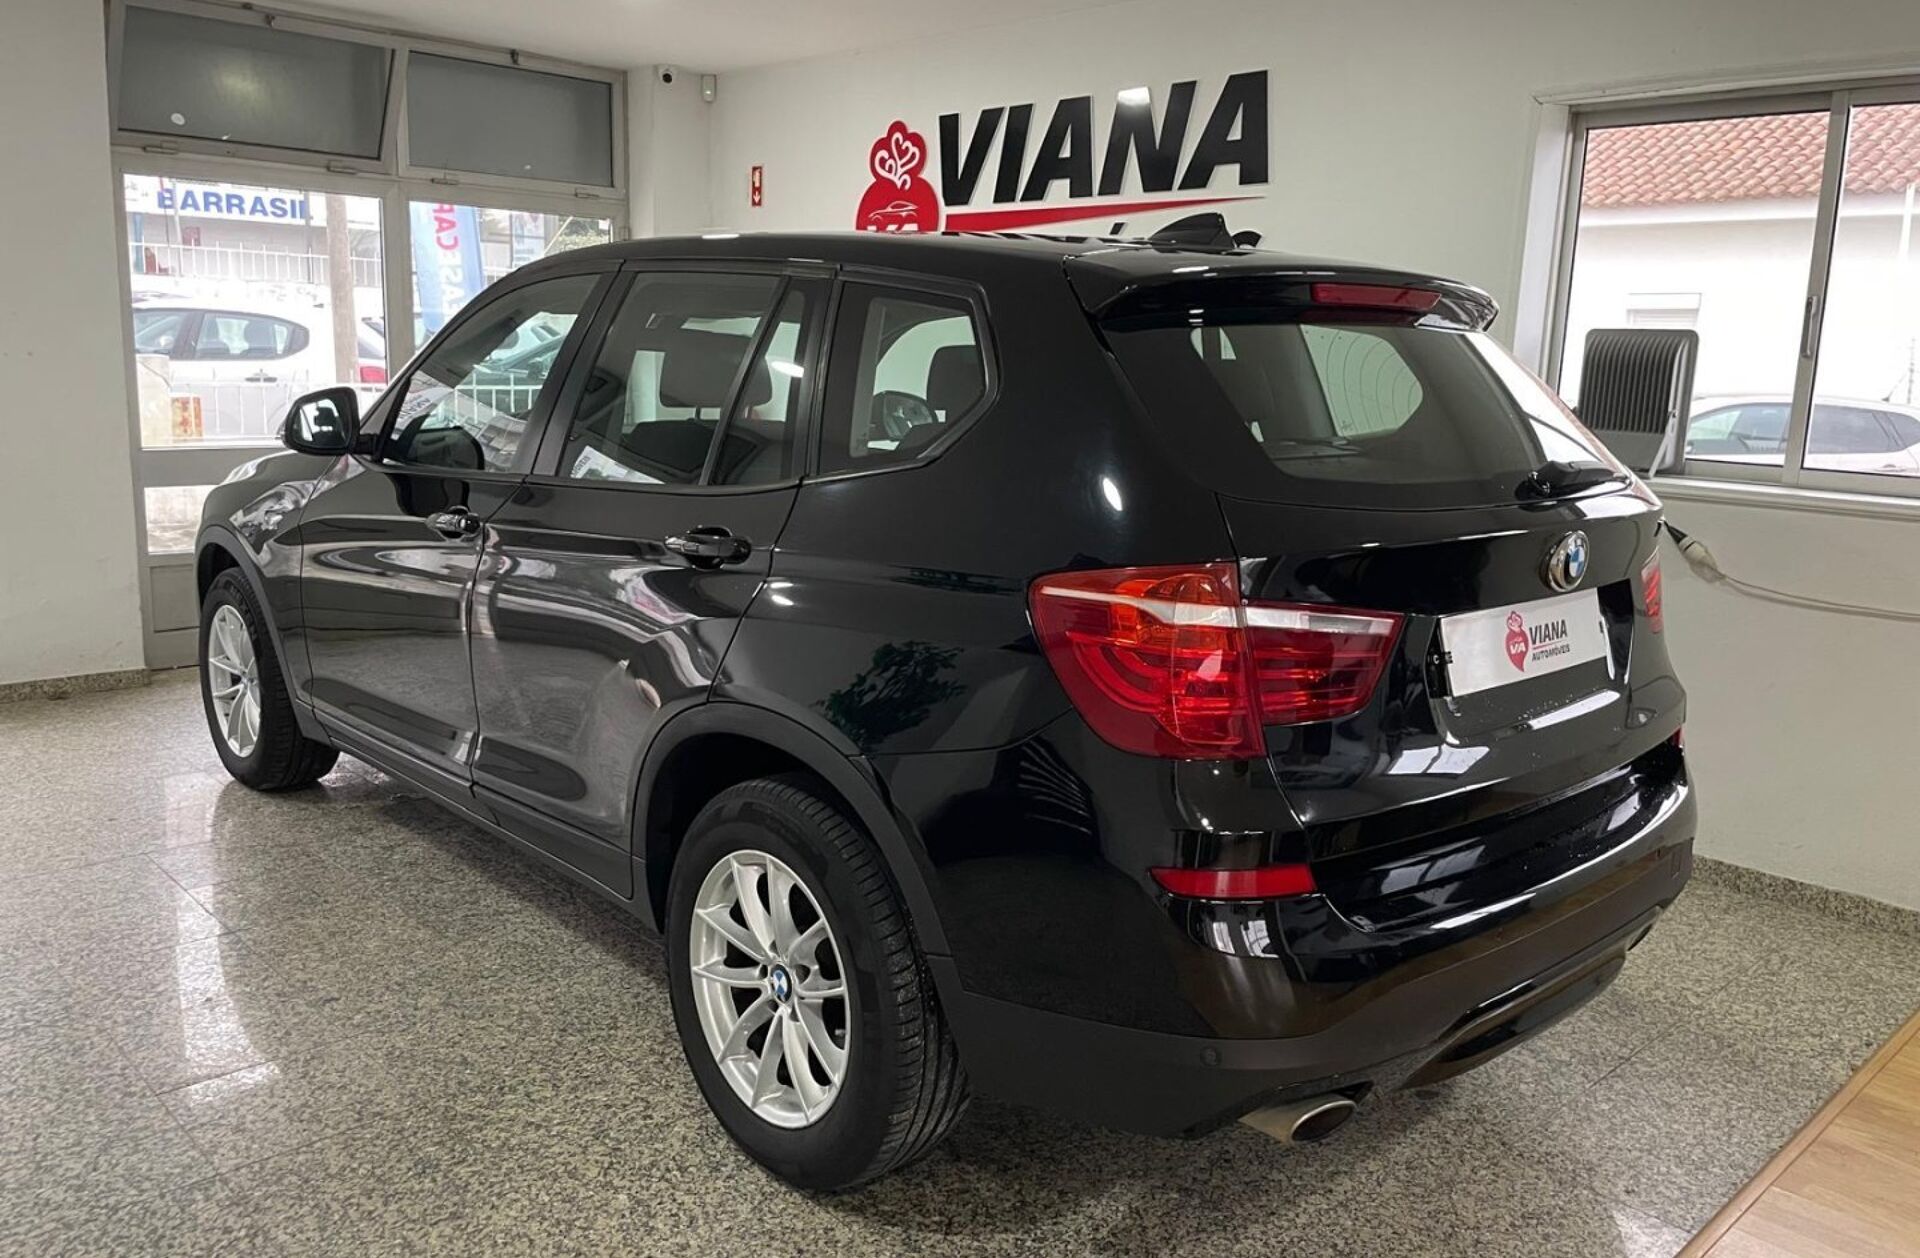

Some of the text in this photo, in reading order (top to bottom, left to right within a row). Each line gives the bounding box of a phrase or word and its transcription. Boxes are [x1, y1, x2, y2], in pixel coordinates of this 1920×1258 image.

[939, 70, 1268, 206] VIANA
[1529, 619, 1568, 645] VIANA
[1510, 642, 1526, 655] VA
